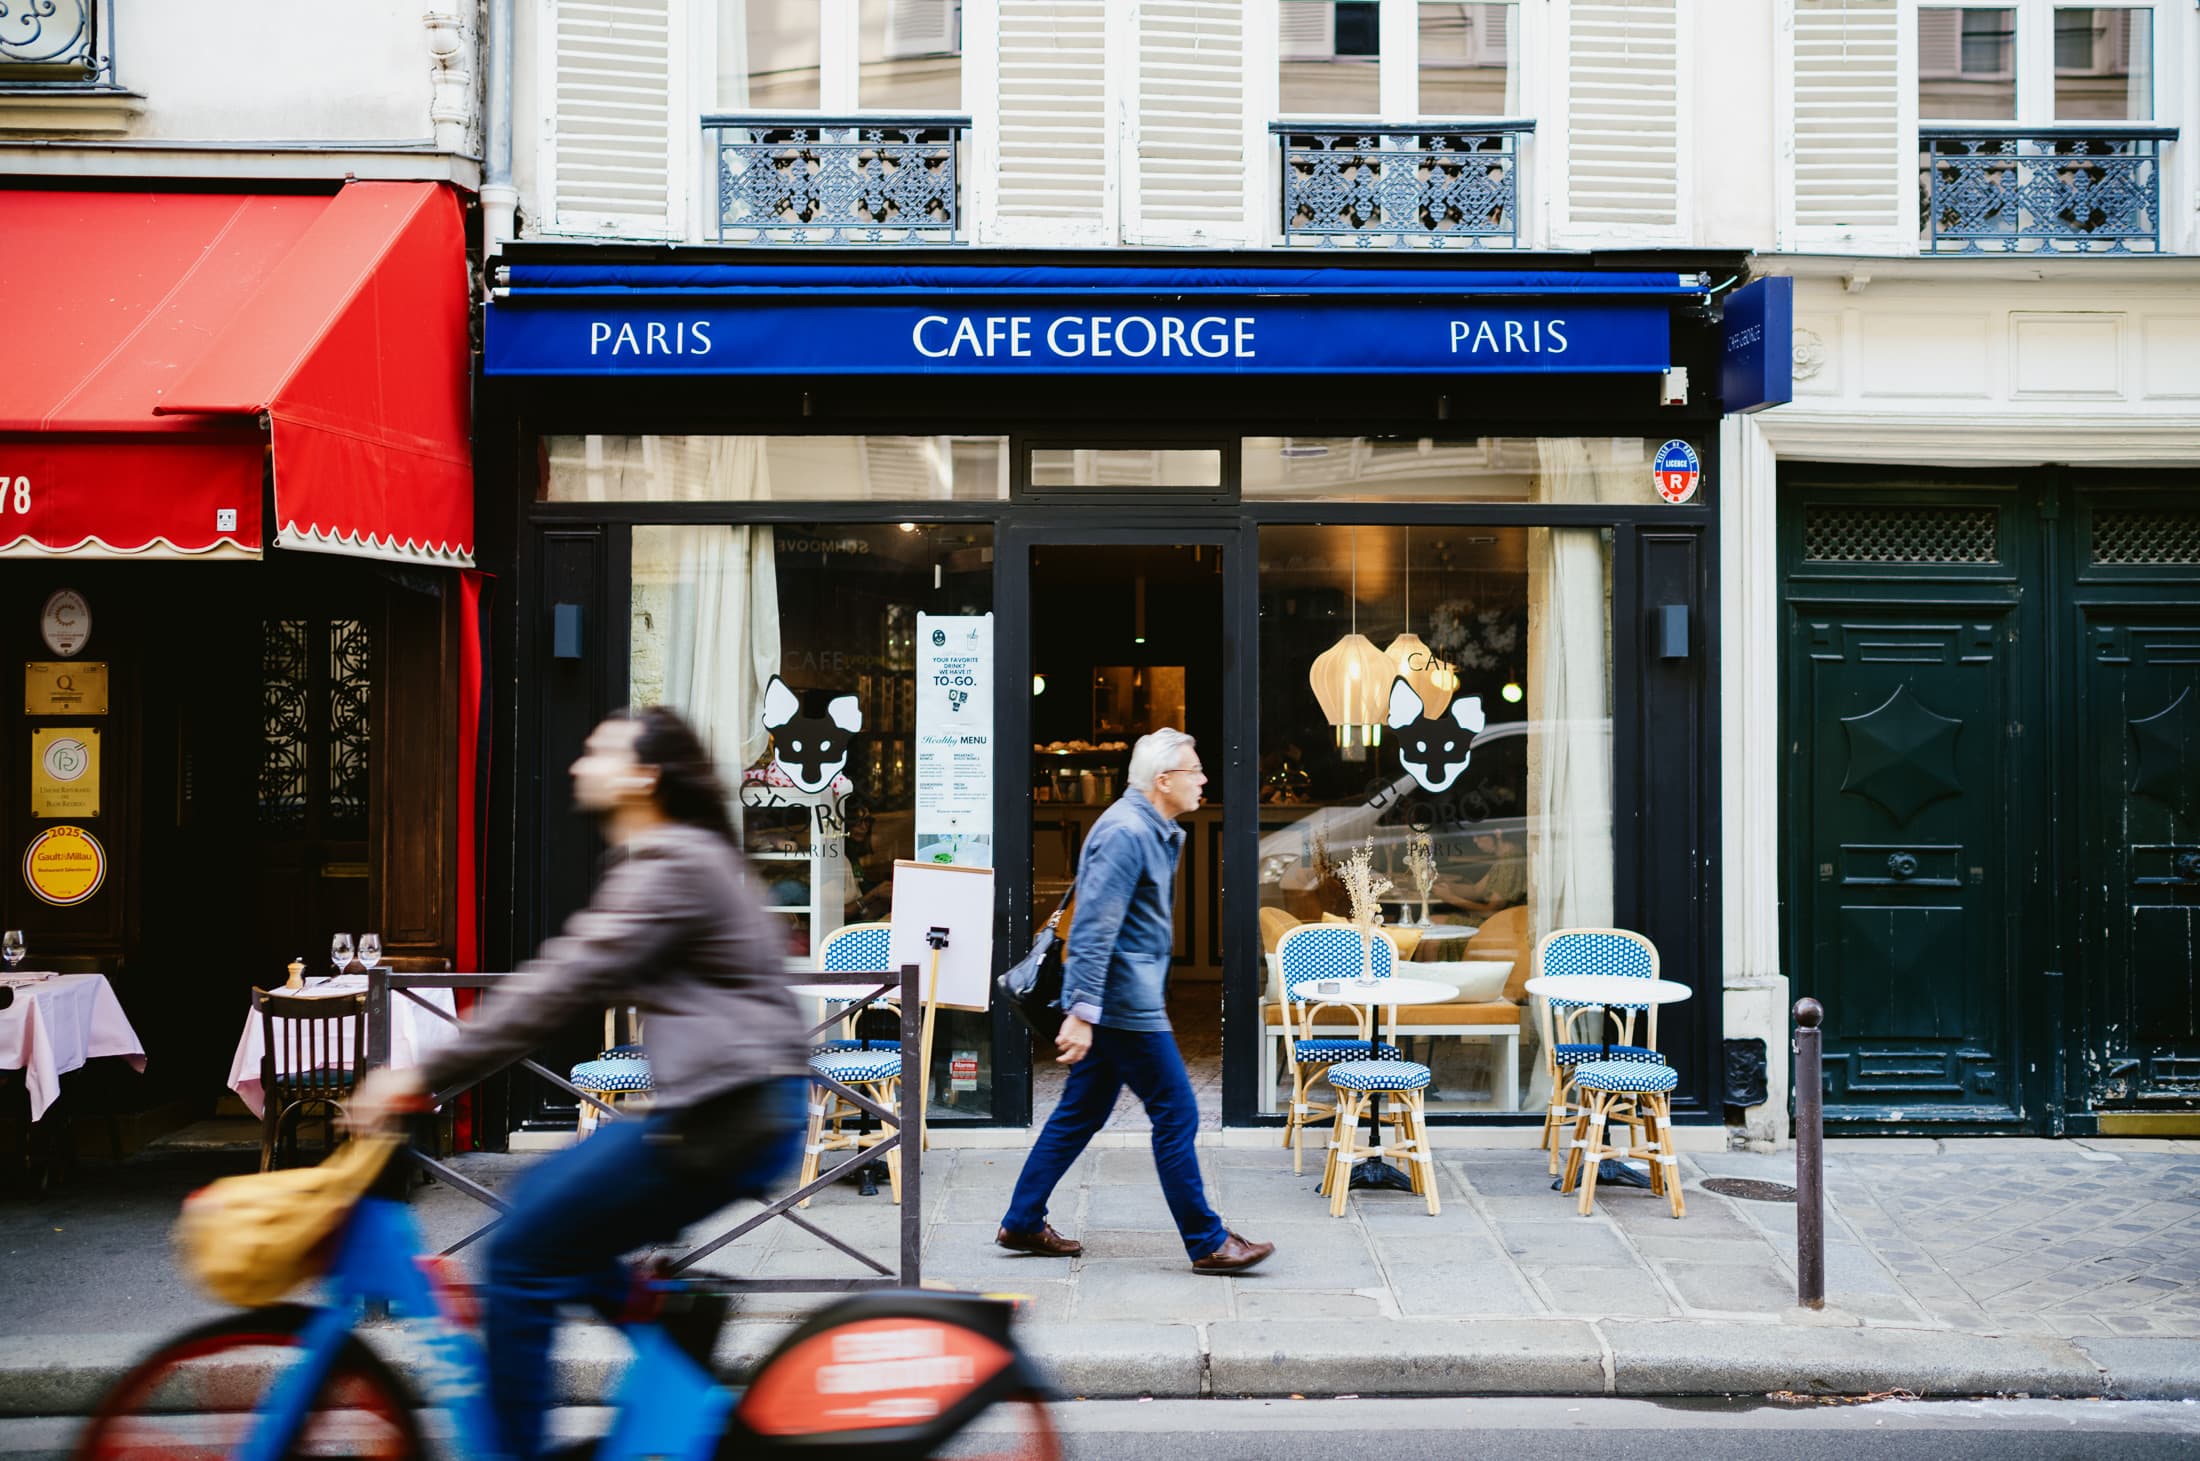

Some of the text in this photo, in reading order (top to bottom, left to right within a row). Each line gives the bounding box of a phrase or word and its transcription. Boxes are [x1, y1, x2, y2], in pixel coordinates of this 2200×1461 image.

[591, 321, 712, 355] PARIS
[912, 315, 1256, 358] CAFE GEORGE
[1450, 320, 1568, 354] PARIS
[1683, 445, 1697, 464] PARIS
[1665, 459, 1688, 468] LICENCE
[1670, 473, 1683, 489] R
[0, 476, 32, 515] 78
[783, 650, 844, 671] CAFE
[56, 674, 76, 692] Q
[933, 676, 977, 686] TO-GO.
[920, 735, 987, 746] Healthy MENU
[50, 827, 80, 838] 2025
[784, 843, 839, 858] PARIS
[1409, 842, 1464, 857] PARIS
